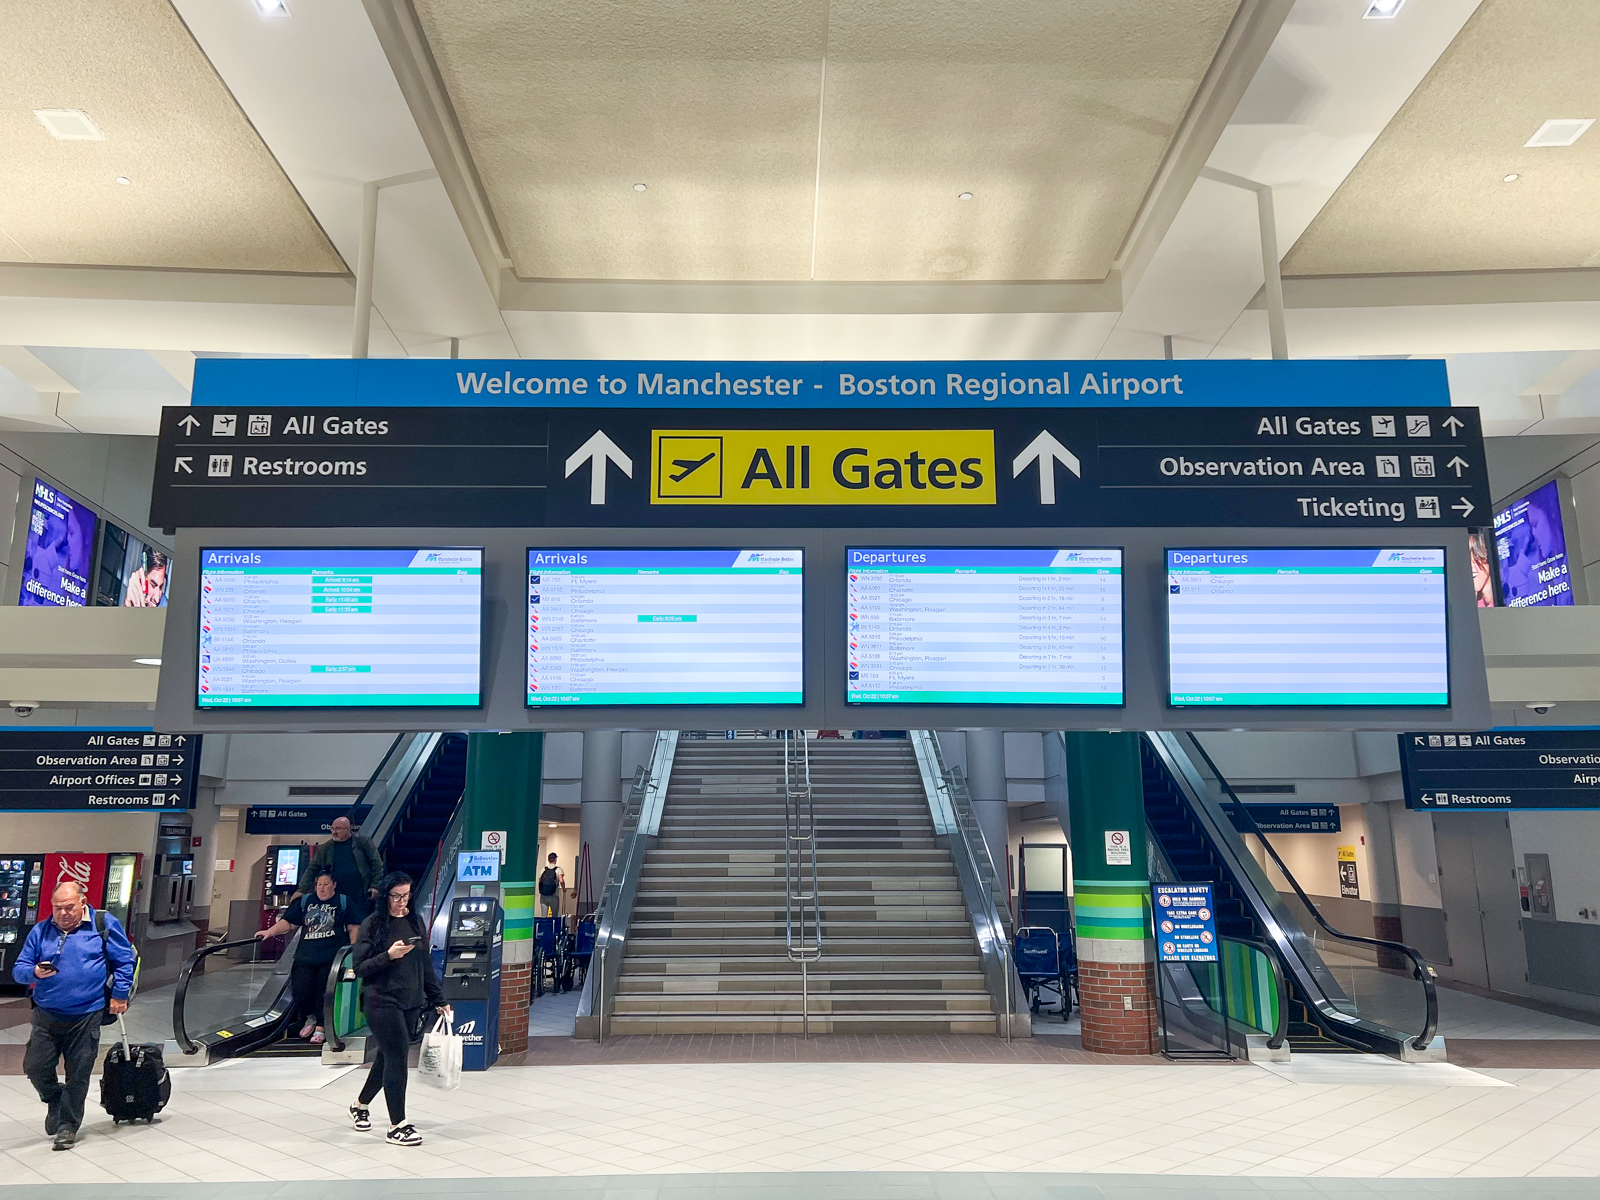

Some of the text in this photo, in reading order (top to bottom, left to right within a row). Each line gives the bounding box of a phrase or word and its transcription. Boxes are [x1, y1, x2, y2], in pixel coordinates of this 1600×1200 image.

[456, 372, 588, 395] Welcome
[598, 373, 627, 395] to
[637, 372, 804, 396] Manchester
[840, 373, 936, 395] Boston
[946, 372, 1070, 401] Regional
[1080, 372, 1183, 401] Airport
[283, 416, 390, 436] All Gates
[1258, 417, 1361, 436] All Gates
[243, 456, 367, 476] Restrooms
[740, 445, 984, 490] All Gates
[1160, 456, 1365, 476] Observation Area
[1297, 496, 1406, 521] Ticketing
[208, 553, 261, 564] Arrivals
[535, 553, 588, 564] Arrivals
[853, 552, 926, 564] Departures
[1173, 553, 1248, 565] Departures
[1538, 564, 1567, 584] Make a
[26, 579, 64, 605] difference
[60, 577, 86, 598] Make a
[1548, 582, 1570, 597] here.
[87, 736, 139, 746] All Gates
[1475, 736, 1526, 745] All Gates
[36, 755, 137, 765] Observation Area
[50, 775, 135, 787] Airport Offices
[88, 795, 149, 805] Restrooms
[1452, 795, 1511, 804] Restrooms
[462, 865, 492, 876] ATM
[1342, 885, 1358, 895] Elevator
[459, 902, 488, 912] ATM
[304, 930, 336, 940] AMERICA
